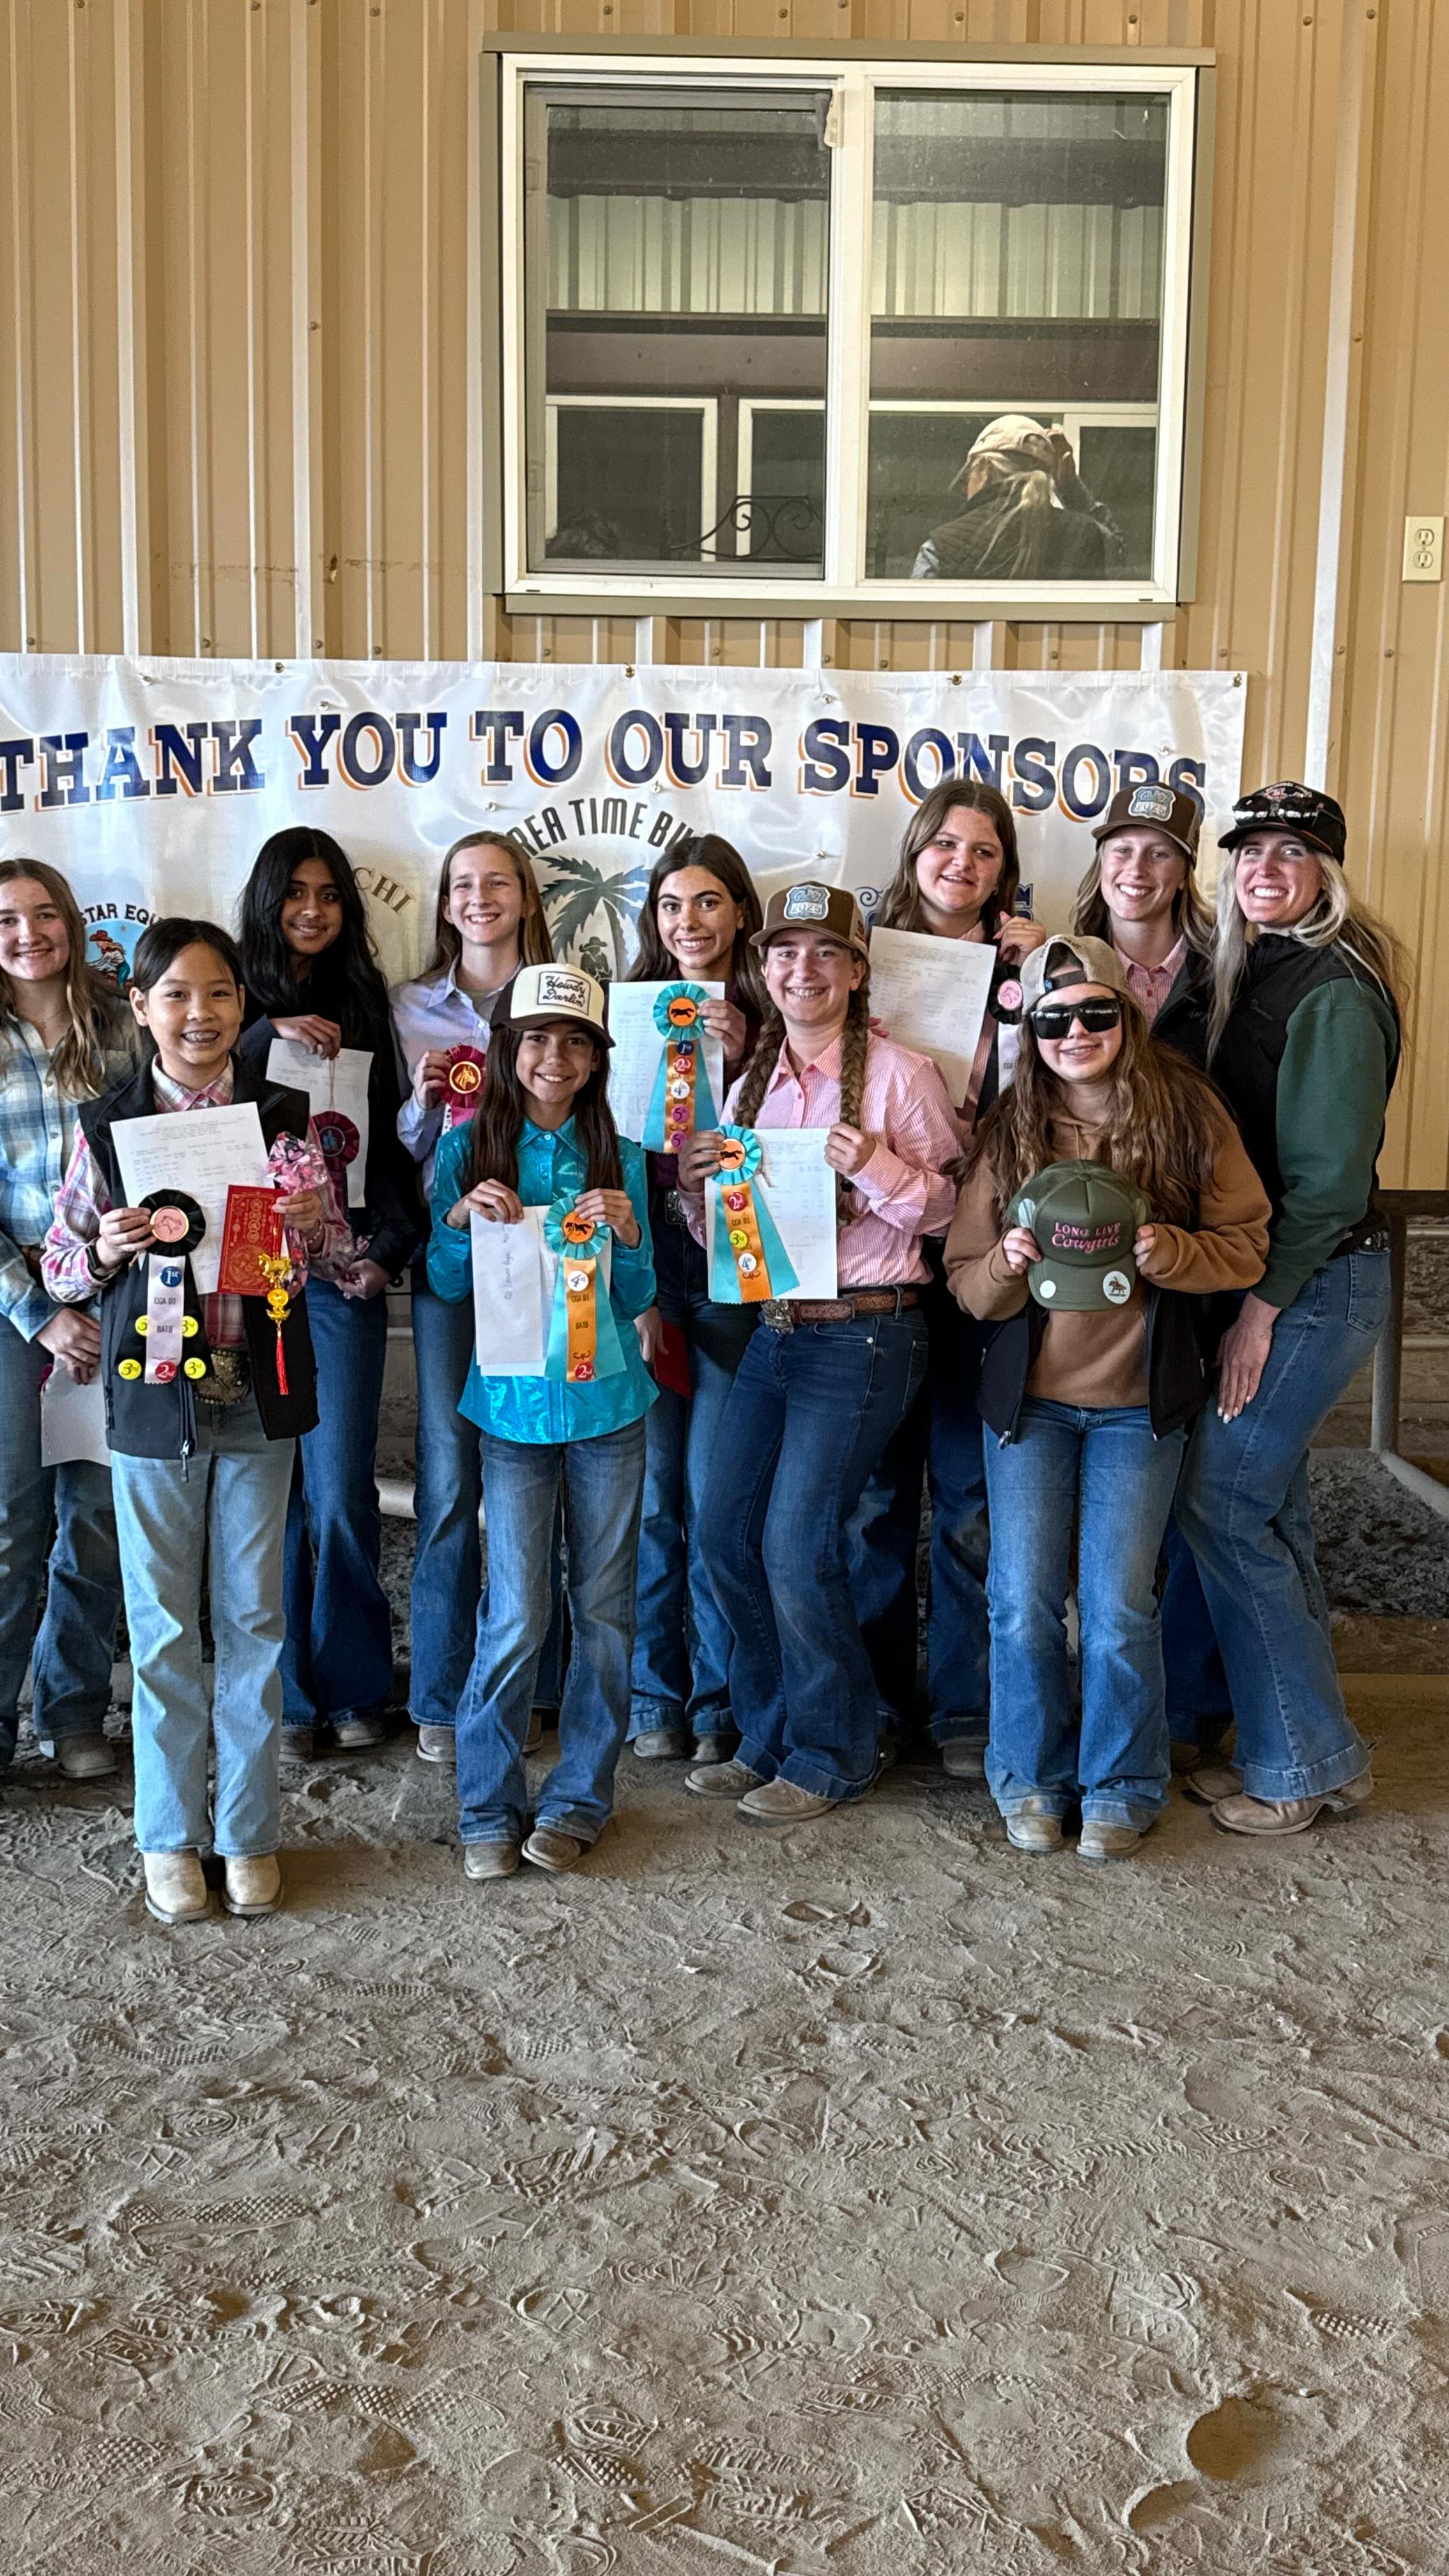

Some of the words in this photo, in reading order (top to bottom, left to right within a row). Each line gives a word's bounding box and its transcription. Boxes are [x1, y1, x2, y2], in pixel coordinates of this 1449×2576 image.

[0, 718, 265, 813] THANK
[286, 711, 447, 788] YOU
[470, 709, 583, 787] TO
[606, 709, 772, 791] OUR
[568, 797, 648, 839] TIME
[792, 904, 822, 912] 2025
[1055, 1221, 1089, 1238] LONG
[1095, 1222, 1121, 1237] LIVE
[1052, 1233, 1120, 1254] Cowgirls
